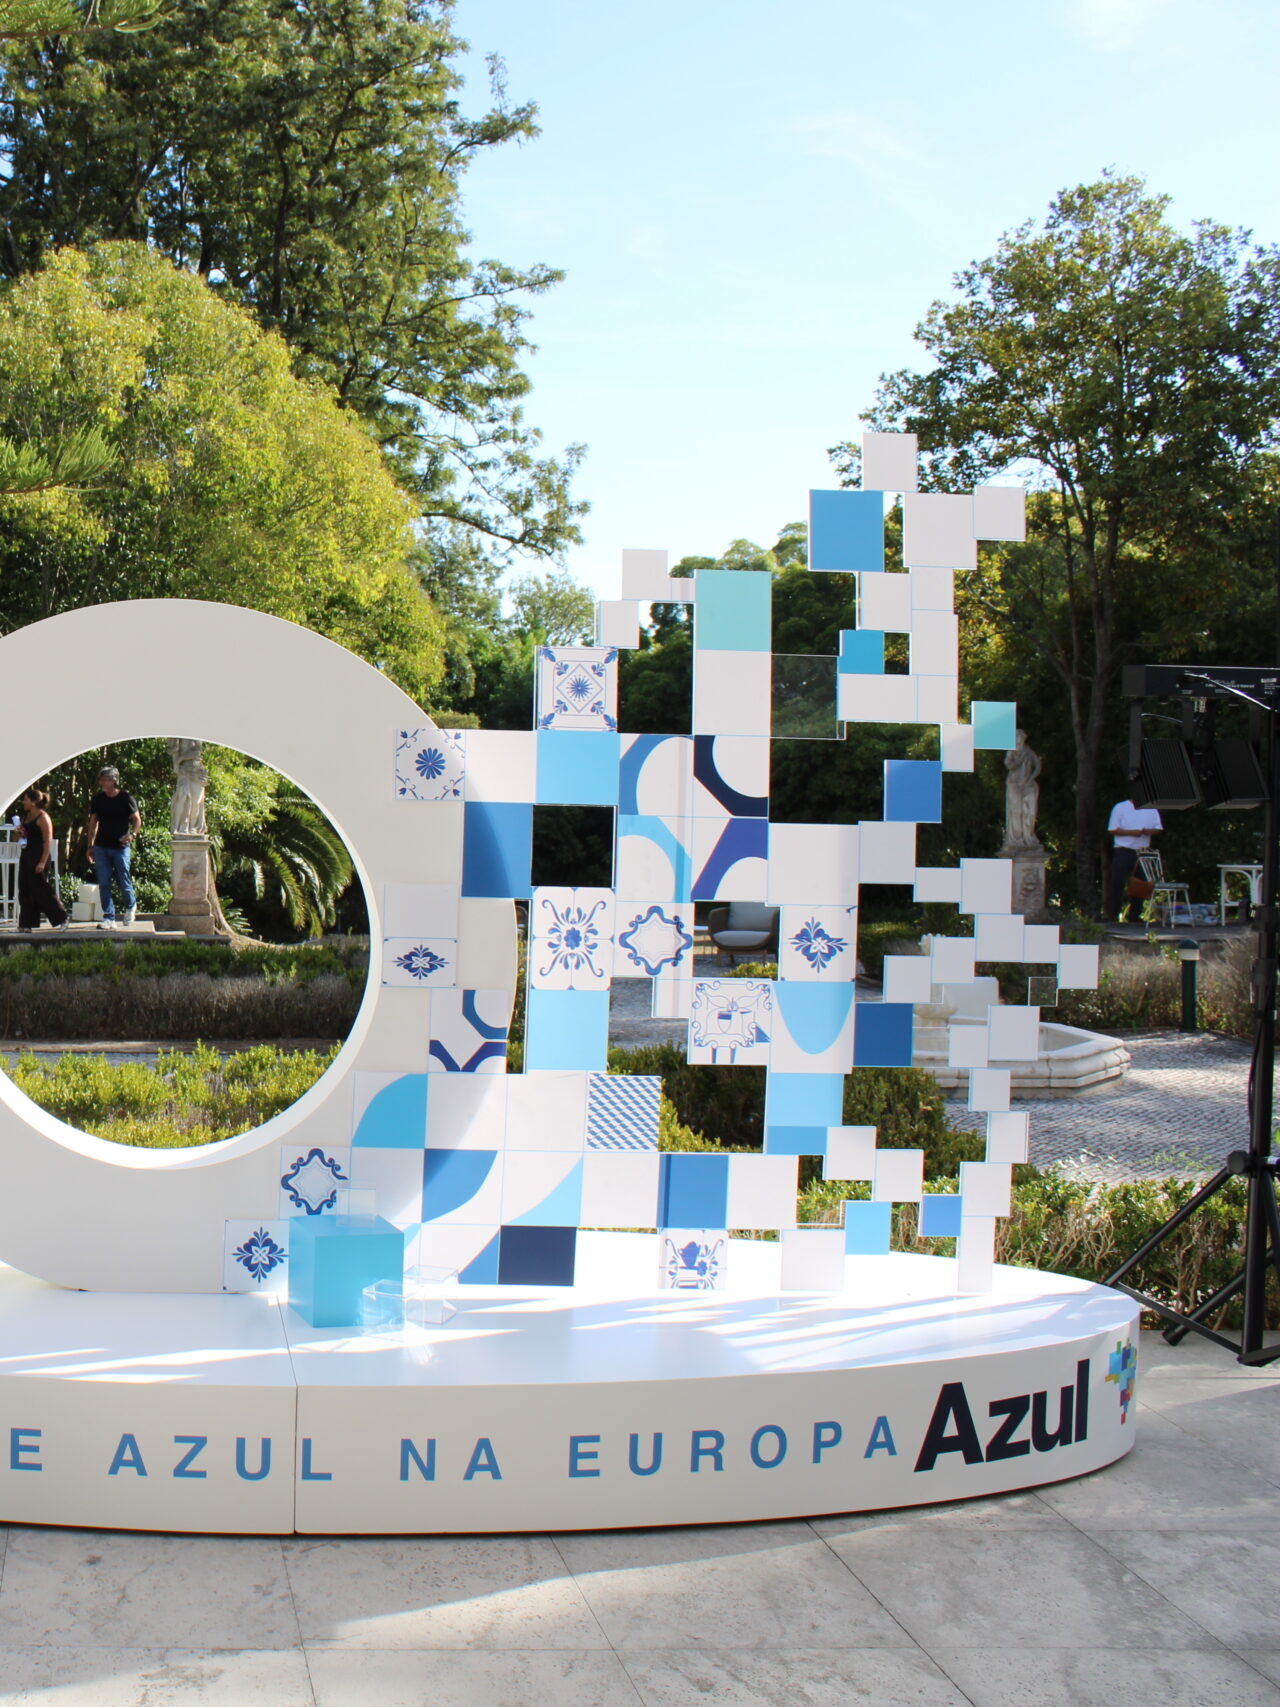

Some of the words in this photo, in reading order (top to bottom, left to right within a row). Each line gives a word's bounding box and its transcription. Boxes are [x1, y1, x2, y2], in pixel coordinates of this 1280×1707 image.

[108, 1433, 334, 1483] AZUL
[399, 1438, 504, 1482] NA
[568, 1415, 899, 1479] EUROPA
[913, 1358, 1091, 1473] Azul
